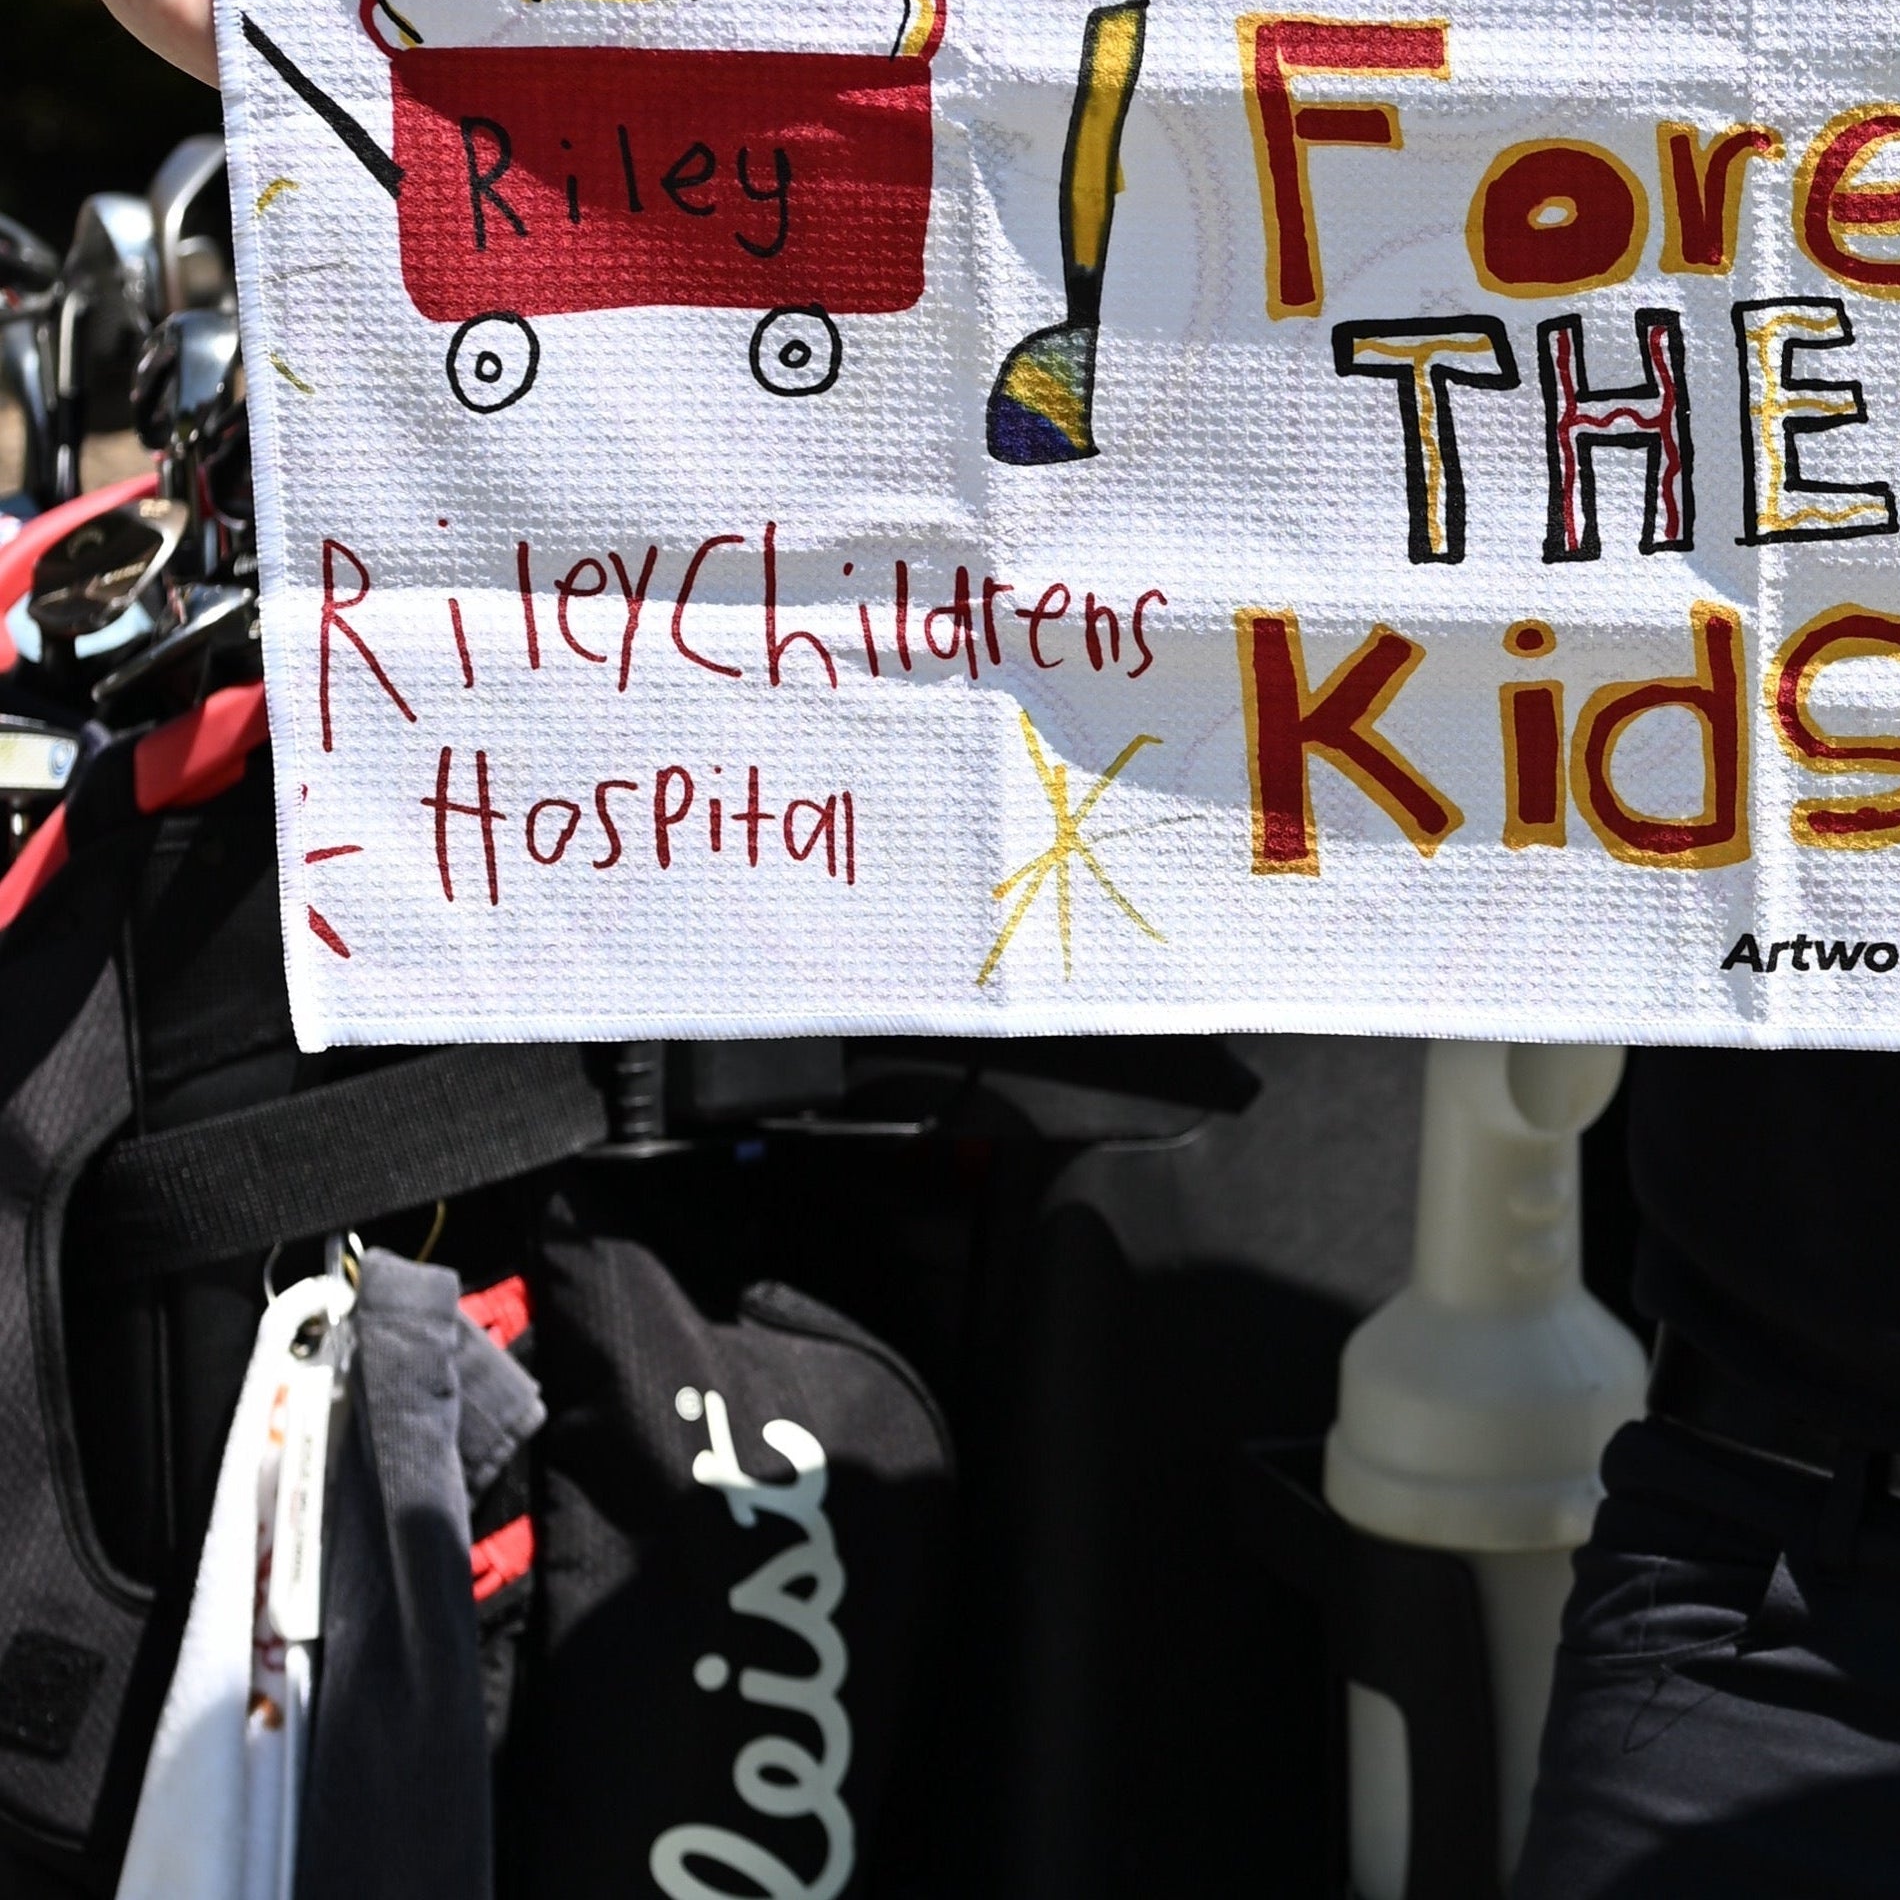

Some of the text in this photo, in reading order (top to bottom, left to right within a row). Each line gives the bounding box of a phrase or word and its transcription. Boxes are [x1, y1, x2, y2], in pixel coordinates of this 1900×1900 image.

[460, 114, 792, 258] Riley
[1332, 297, 1900, 565] THE
[420, 745, 856, 906] Hospital
